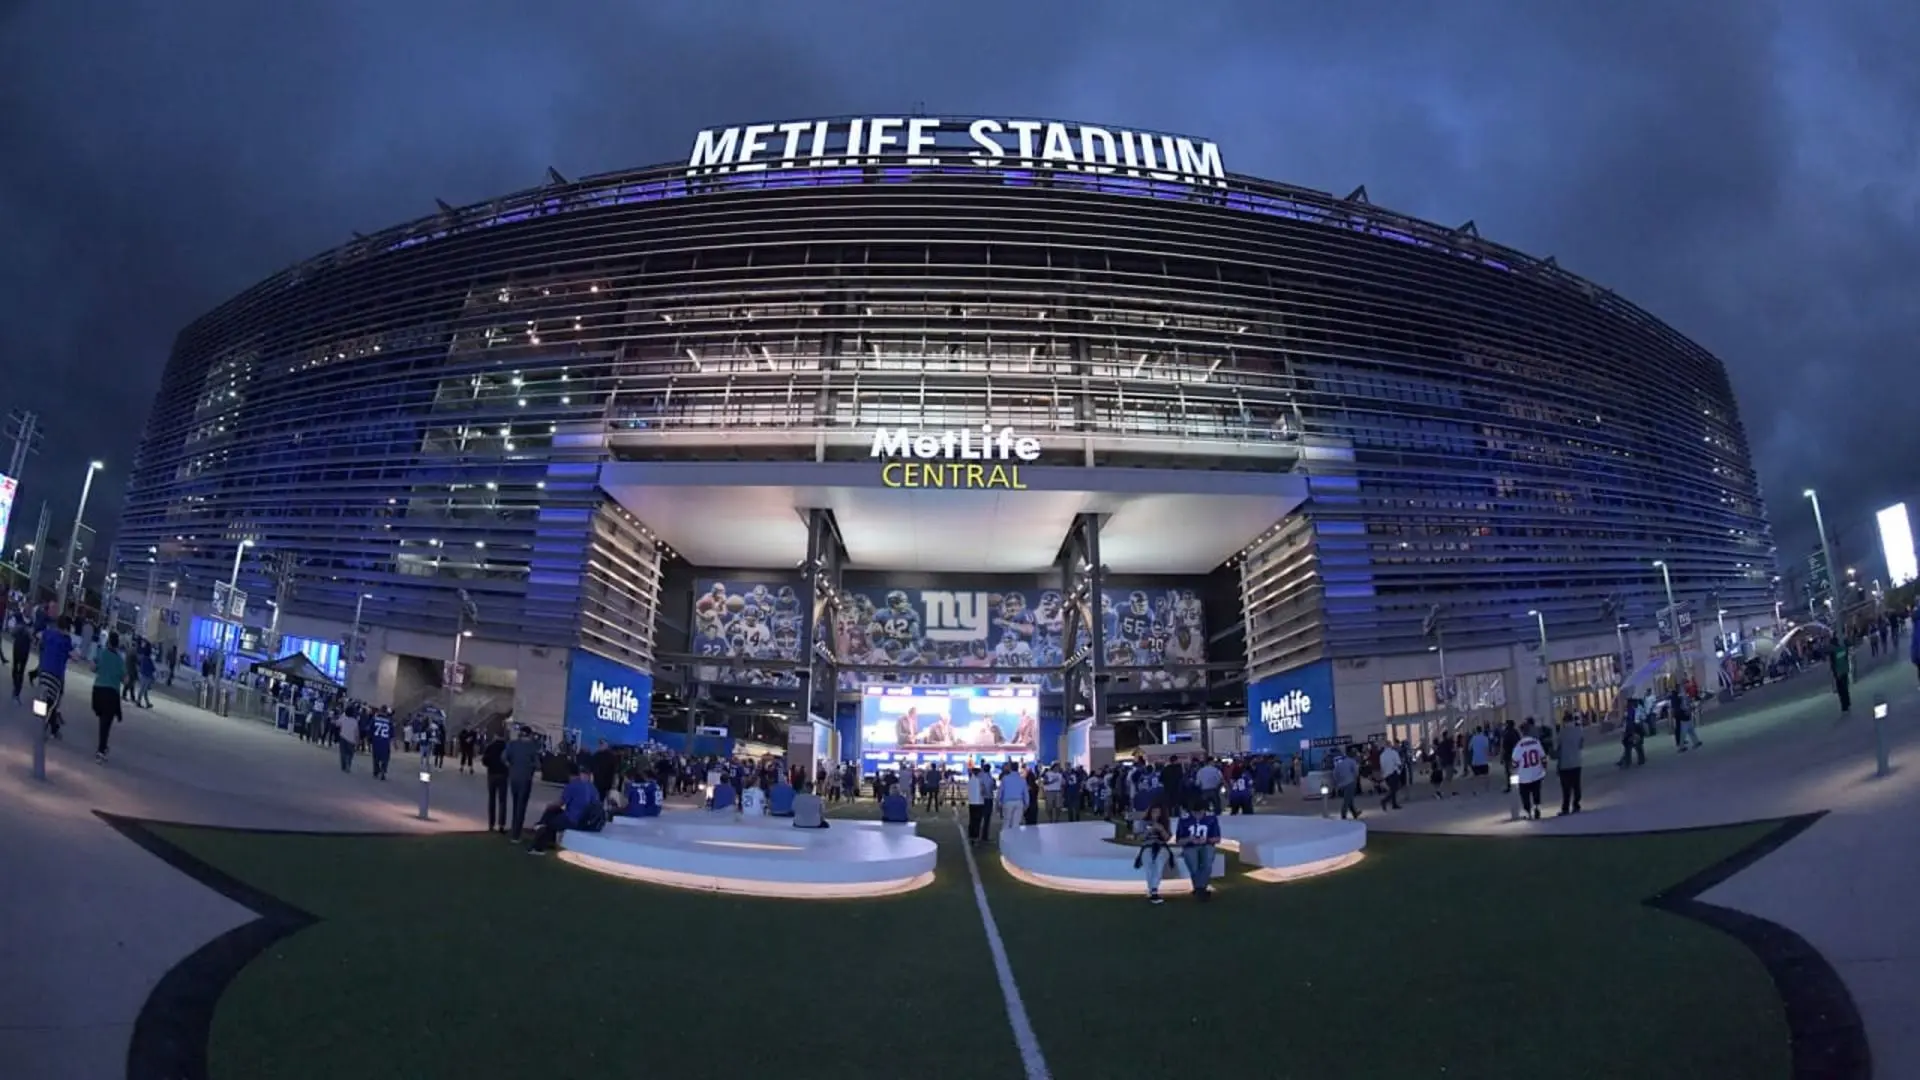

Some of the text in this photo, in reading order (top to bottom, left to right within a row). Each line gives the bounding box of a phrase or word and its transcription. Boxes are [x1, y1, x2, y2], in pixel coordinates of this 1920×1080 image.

[686, 117, 1228, 189] METLIFE STADIUM
[869, 424, 1042, 461] MetLife
[882, 462, 1028, 489] CENTRAL
[884, 618, 909, 639] 42
[589, 680, 639, 714] MetLife
[1260, 689, 1312, 723] MetLife
[597, 705, 631, 725] CENTRAL
[1268, 716, 1304, 733] CENTRAL
[374, 722, 390, 738] 72
[1521, 748, 1540, 769] 10
